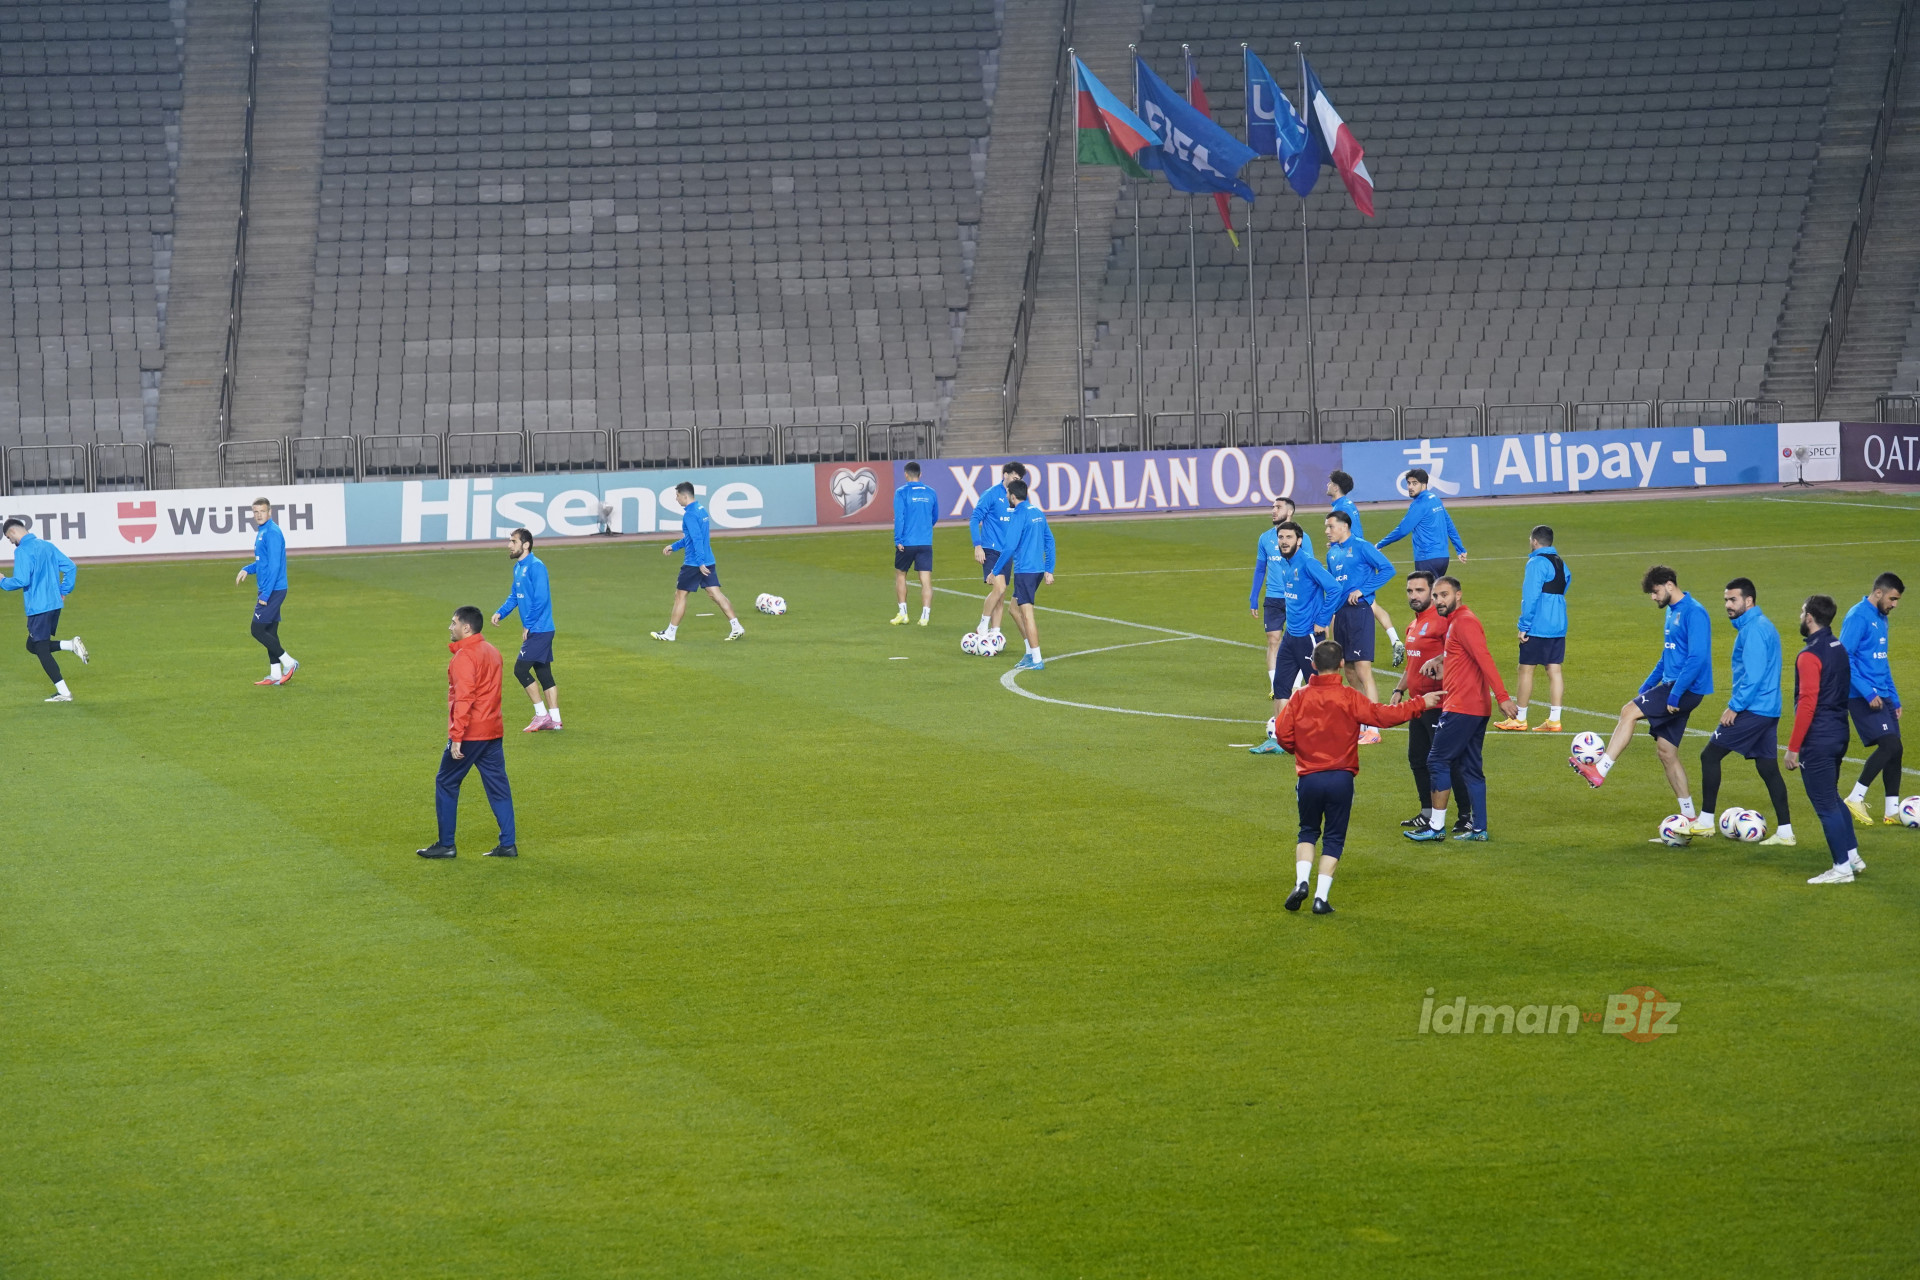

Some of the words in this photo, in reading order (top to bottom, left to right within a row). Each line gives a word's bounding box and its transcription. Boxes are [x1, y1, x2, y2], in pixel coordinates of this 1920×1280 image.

[1145, 100, 1225, 178] FIFA
[1864, 434, 1920, 478] QAT
[0, 512, 86, 541] TH
[168, 503, 314, 535] WÜRTH
[401, 478, 763, 543] Hisense
